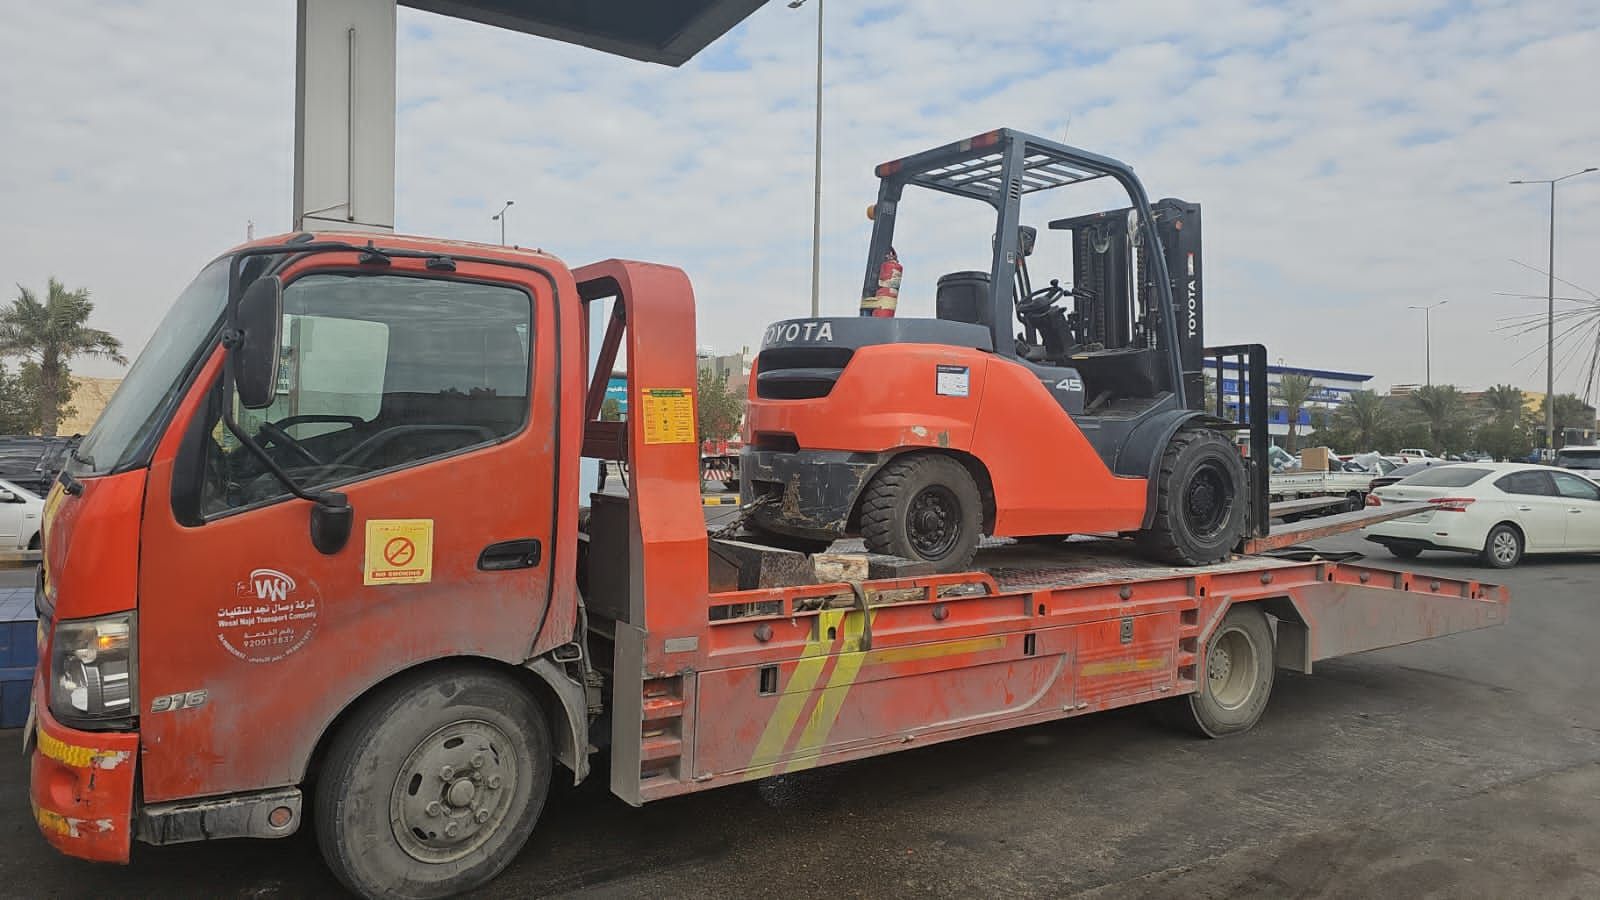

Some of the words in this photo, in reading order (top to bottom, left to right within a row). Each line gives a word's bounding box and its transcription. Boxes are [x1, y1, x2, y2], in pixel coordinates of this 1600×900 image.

[1188, 280, 1196, 338] TOYOTA
[1056, 379, 1082, 391] 45
[253, 605, 270, 615] نجد
[256, 614, 288, 624] Transport
[289, 611, 317, 621] Company
[151, 690, 208, 713] 916
